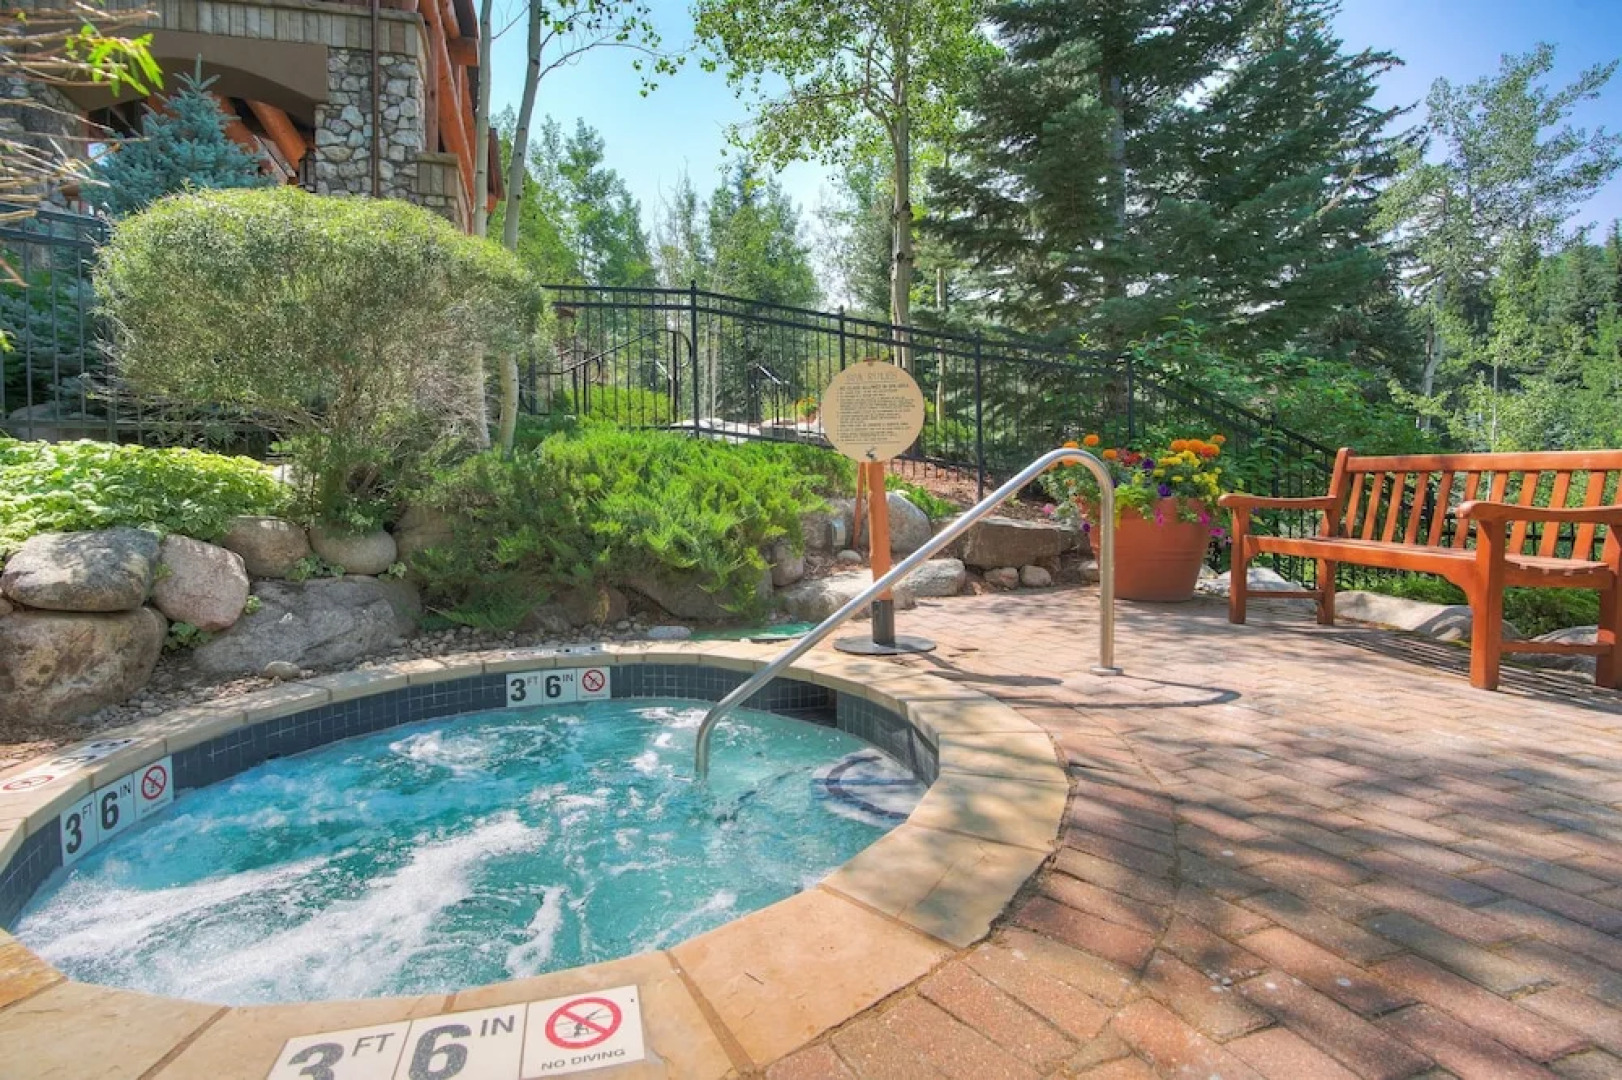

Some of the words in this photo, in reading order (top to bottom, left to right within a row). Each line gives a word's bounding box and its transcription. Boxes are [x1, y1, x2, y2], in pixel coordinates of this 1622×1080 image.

[510, 678, 527, 702] 3
[527, 675, 539, 687] FT
[546, 675, 562, 698] 6
[562, 673, 574, 682] IN
[65, 813, 82, 854] 3
[82, 801, 93, 821] FT
[101, 790, 119, 830] 6
[119, 781, 131, 799] IN
[351, 1032, 396, 1057] FT
[408, 1023, 473, 1080] 6
[480, 1014, 516, 1038] IN
[540, 1059, 567, 1070] NO
[570, 1047, 626, 1065] DIVING
